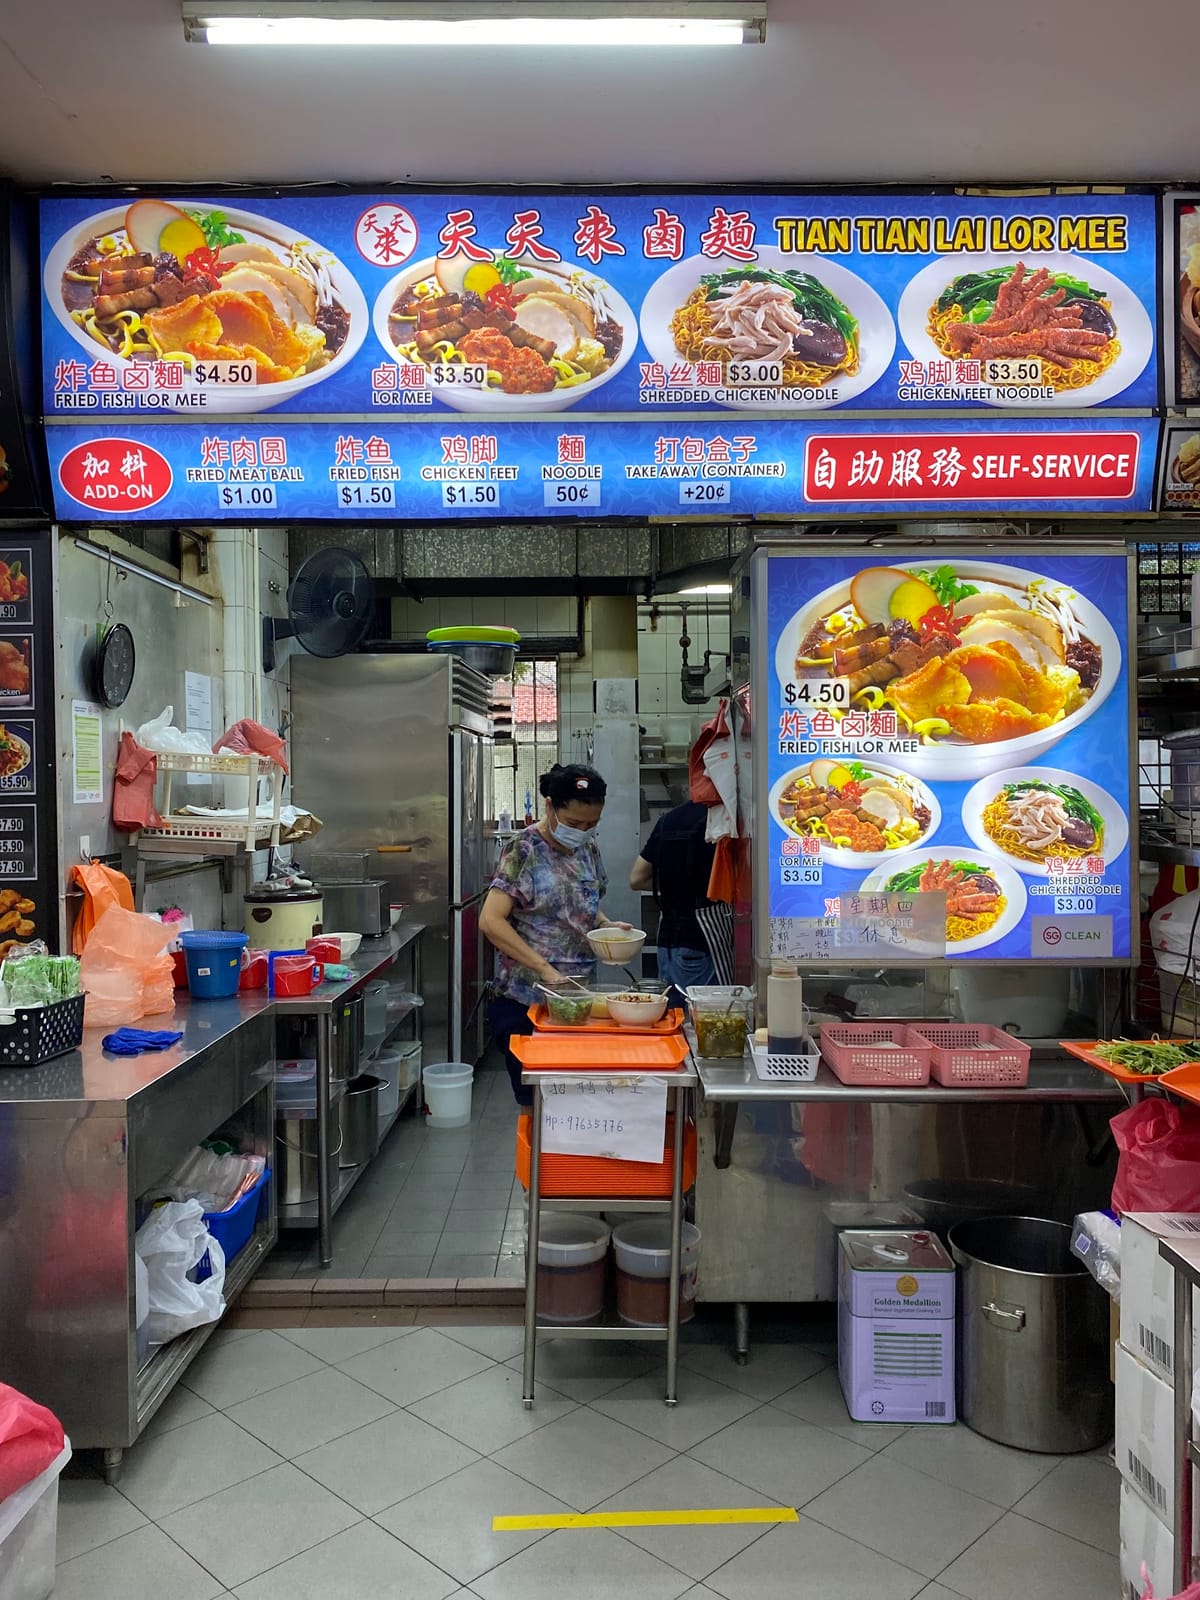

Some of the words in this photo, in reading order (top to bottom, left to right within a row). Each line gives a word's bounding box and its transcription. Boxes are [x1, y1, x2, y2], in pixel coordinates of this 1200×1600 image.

[777, 218, 848, 252] TIAN
[855, 218, 932, 252] TIAN
[936, 218, 987, 252] LAI
[989, 217, 1056, 251] LOR
[1059, 217, 1126, 249] MEE
[195, 364, 252, 385] $4.50
[433, 366, 485, 385] $3.50
[729, 364, 780, 383] $3.00
[989, 362, 1039, 382] $3.50
[55, 393, 97, 408] FRIED
[104, 393, 135, 407] FISH
[140, 393, 169, 407] LOR
[175, 393, 207, 407] MEE
[373, 392, 400, 404] LOR
[404, 391, 432, 404] MEE
[640, 390, 711, 403] SHREDDED
[714, 389, 777, 402] CHICKEN
[781, 388, 839, 401] NOODLE
[899, 387, 962, 400] CHICKEN
[964, 387, 992, 400] FEET
[996, 386, 1053, 399] NOODLE
[202, 437, 287, 466] 炸肉圆
[336, 436, 392, 464] 炸鱼
[442, 435, 497, 464] 鸡脚
[655, 436, 757, 463] 打包盒子
[81, 449, 148, 482] 加料
[421, 466, 486, 480] CHICKEN
[490, 466, 518, 480] FEET
[542, 466, 601, 479] NOODLE
[626, 466, 657, 478] TAKE
[660, 465, 698, 478] AWAY
[702, 464, 786, 478] (CONTAINER)
[971, 454, 1130, 480] SELF-SERVICE
[188, 468, 224, 481] FRIED
[229, 468, 267, 481] MEAT
[271, 468, 303, 481] BALL
[330, 467, 368, 480] FRIED
[371, 467, 400, 480] FISH
[84, 484, 153, 499] ADD-ON
[222, 487, 272, 505] $1.00
[342, 486, 392, 505] $1.50
[446, 485, 496, 504] $1.50
[556, 484, 588, 503] 50¢
[684, 483, 725, 501] +20¢
[784, 682, 845, 705] $4.50
[780, 741, 818, 753] FRIED
[823, 741, 850, 753] FISH
[857, 741, 885, 753] LOR
[889, 741, 918, 753] MEE
[2, 776, 27, 788] $5.90
[780, 857, 800, 866] LOR
[802, 857, 823, 866] MEE
[783, 870, 820, 882] $3.50
[1049, 876, 1101, 885] SHREDDED
[1030, 885, 1075, 895] CHICKEN
[1078, 885, 1121, 895] NOODLE
[850, 896, 913, 915] 星期四
[1057, 899, 1094, 911] $3.00
[1045, 931, 1059, 940] SG
[1064, 931, 1101, 940] CLEAN
[567, 1116, 624, 1132] 97635776
[874, 1298, 901, 1306] Golden
[903, 1298, 942, 1307] Medallion
